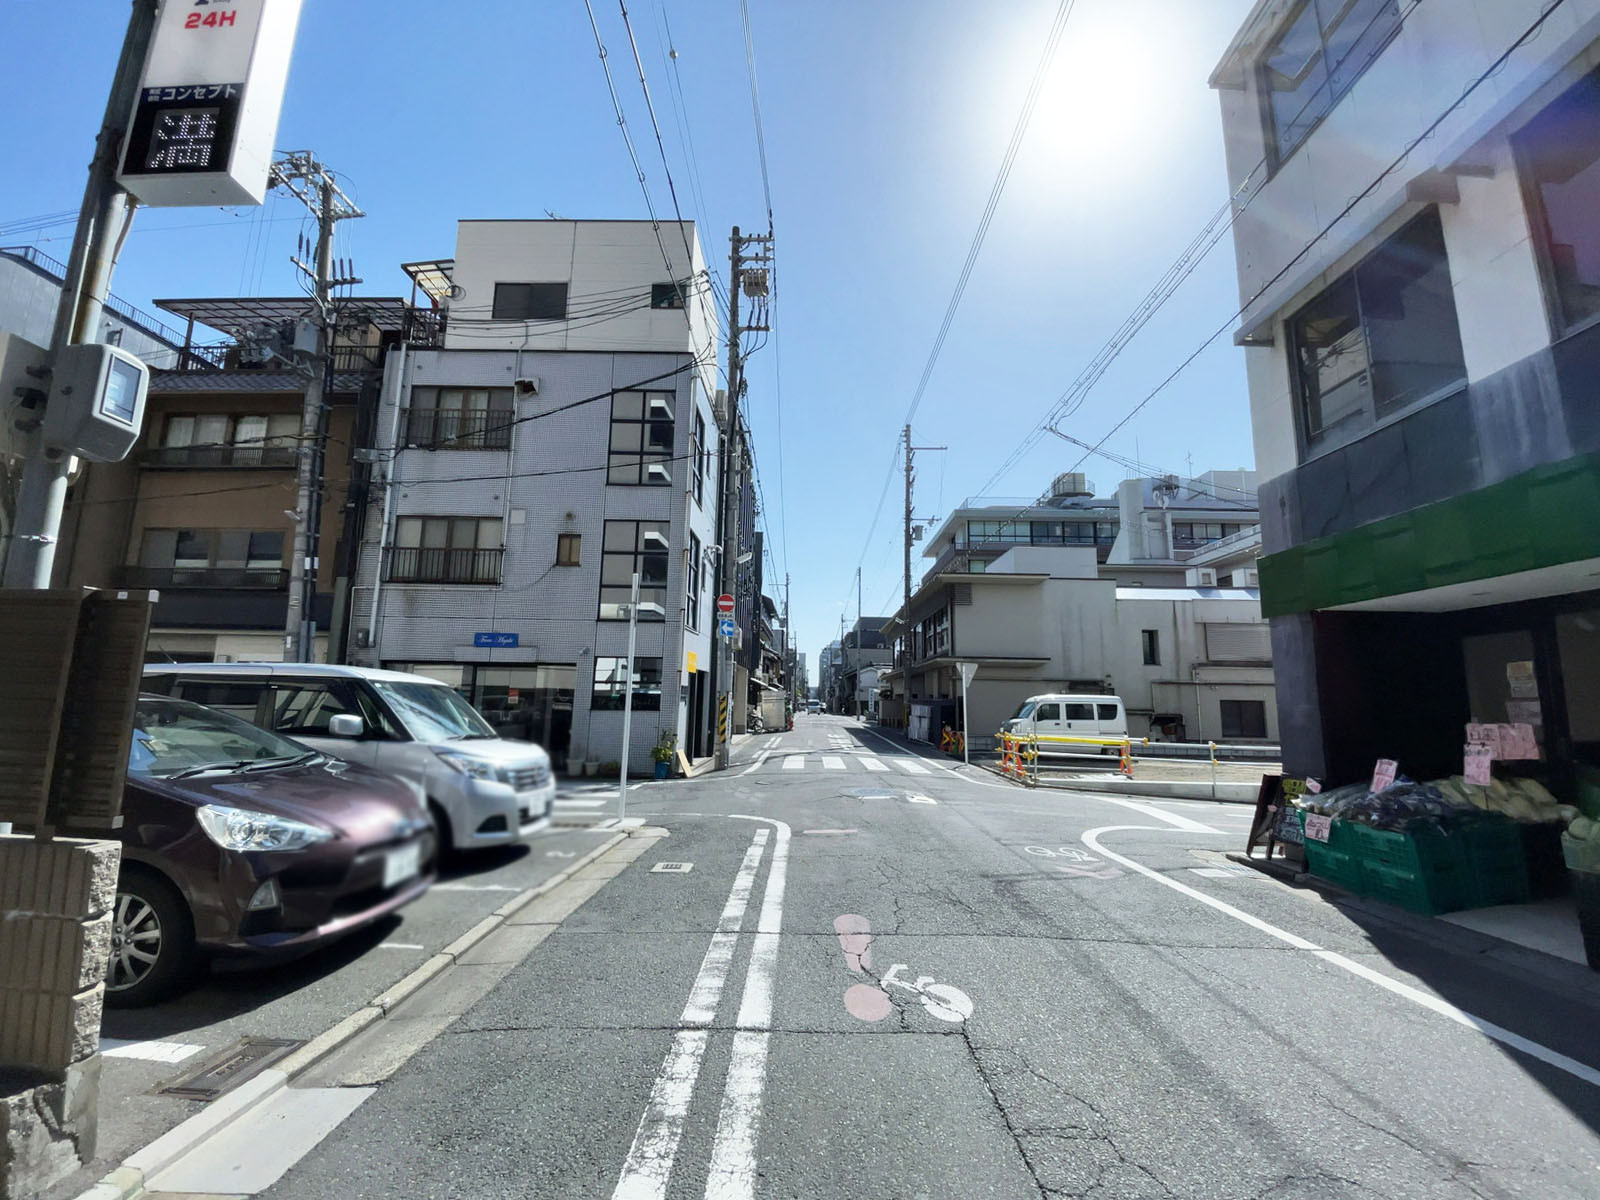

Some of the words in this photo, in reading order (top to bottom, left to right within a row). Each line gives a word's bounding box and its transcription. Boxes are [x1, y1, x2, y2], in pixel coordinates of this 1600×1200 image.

[184, 9, 237, 29] 24H
[162, 84, 236, 100] コンセプト
[151, 114, 217, 168] 満
